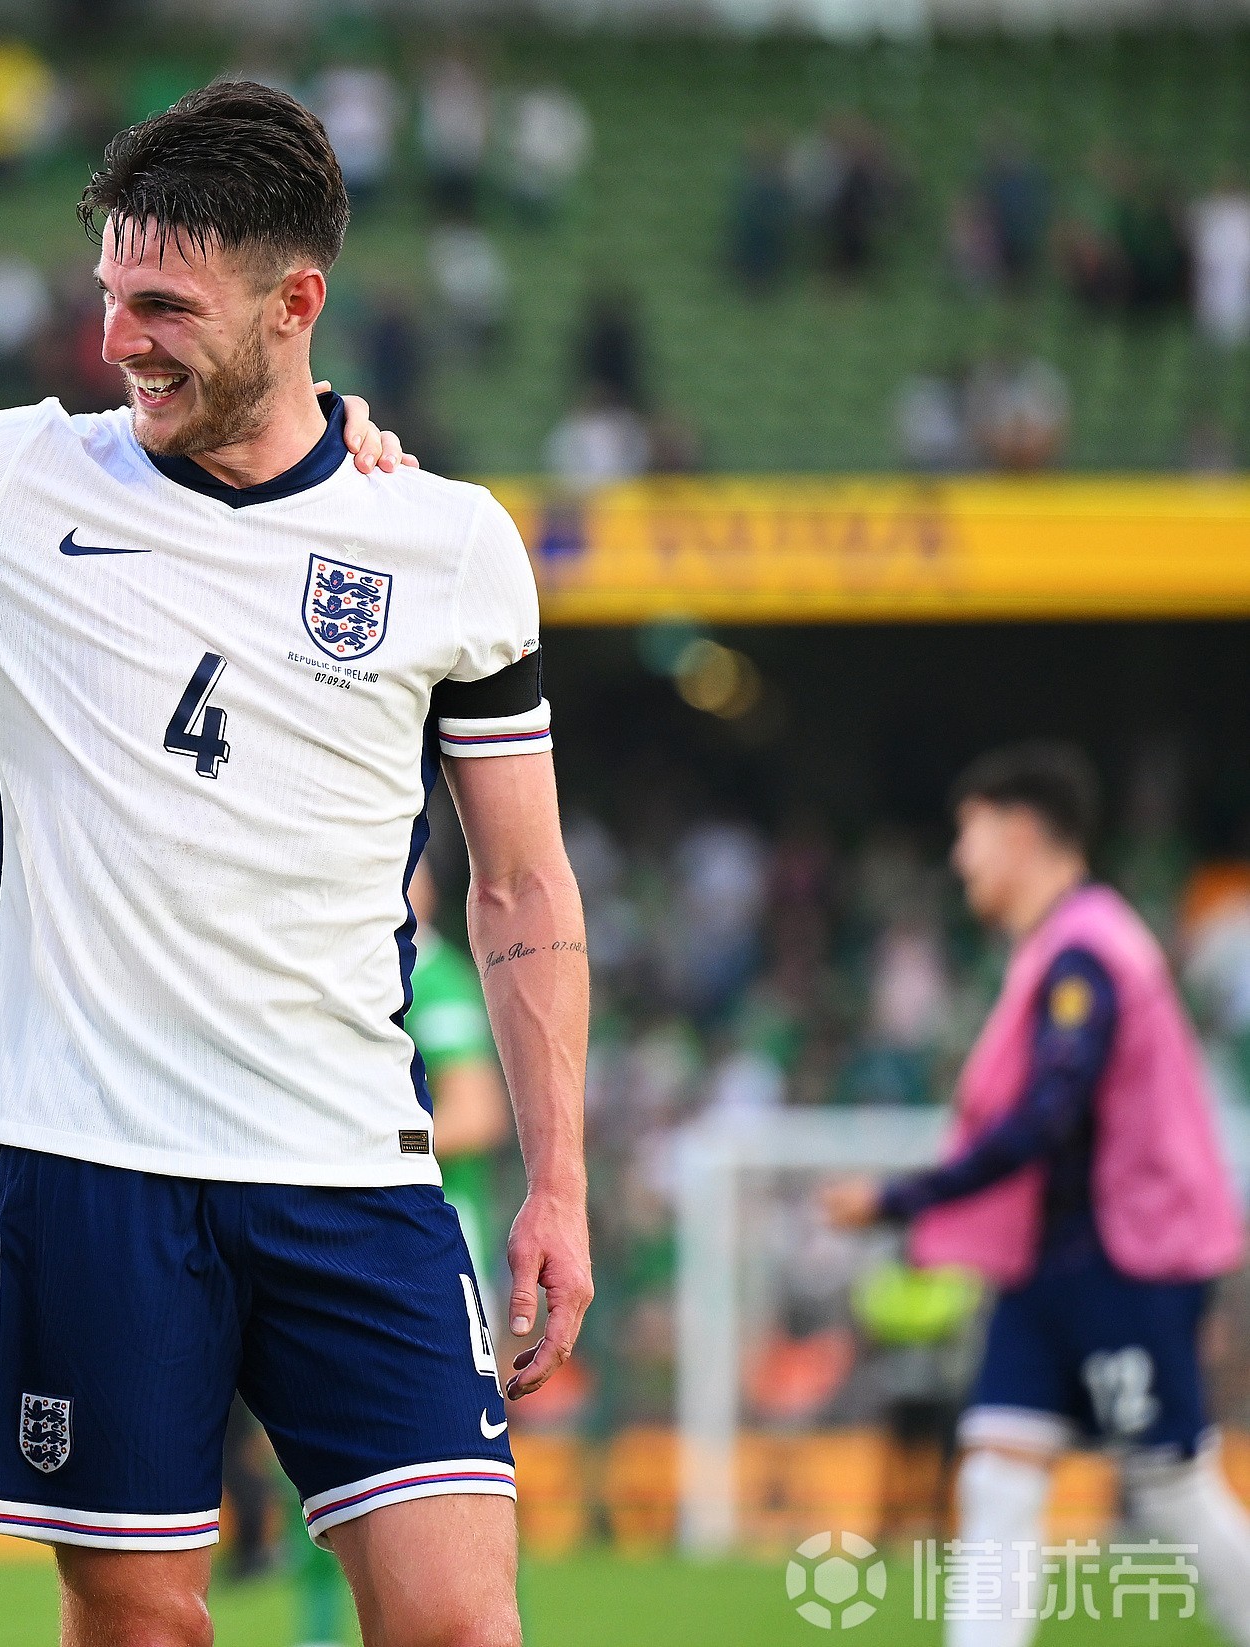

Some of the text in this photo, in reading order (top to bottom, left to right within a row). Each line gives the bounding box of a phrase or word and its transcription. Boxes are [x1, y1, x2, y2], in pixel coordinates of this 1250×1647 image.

[287, 651, 379, 683] REPUBLIC OF IRELAND
[314, 672, 352, 690] 07.09.24
[163, 651, 231, 780] 4
[458, 1273, 504, 1399] 4
